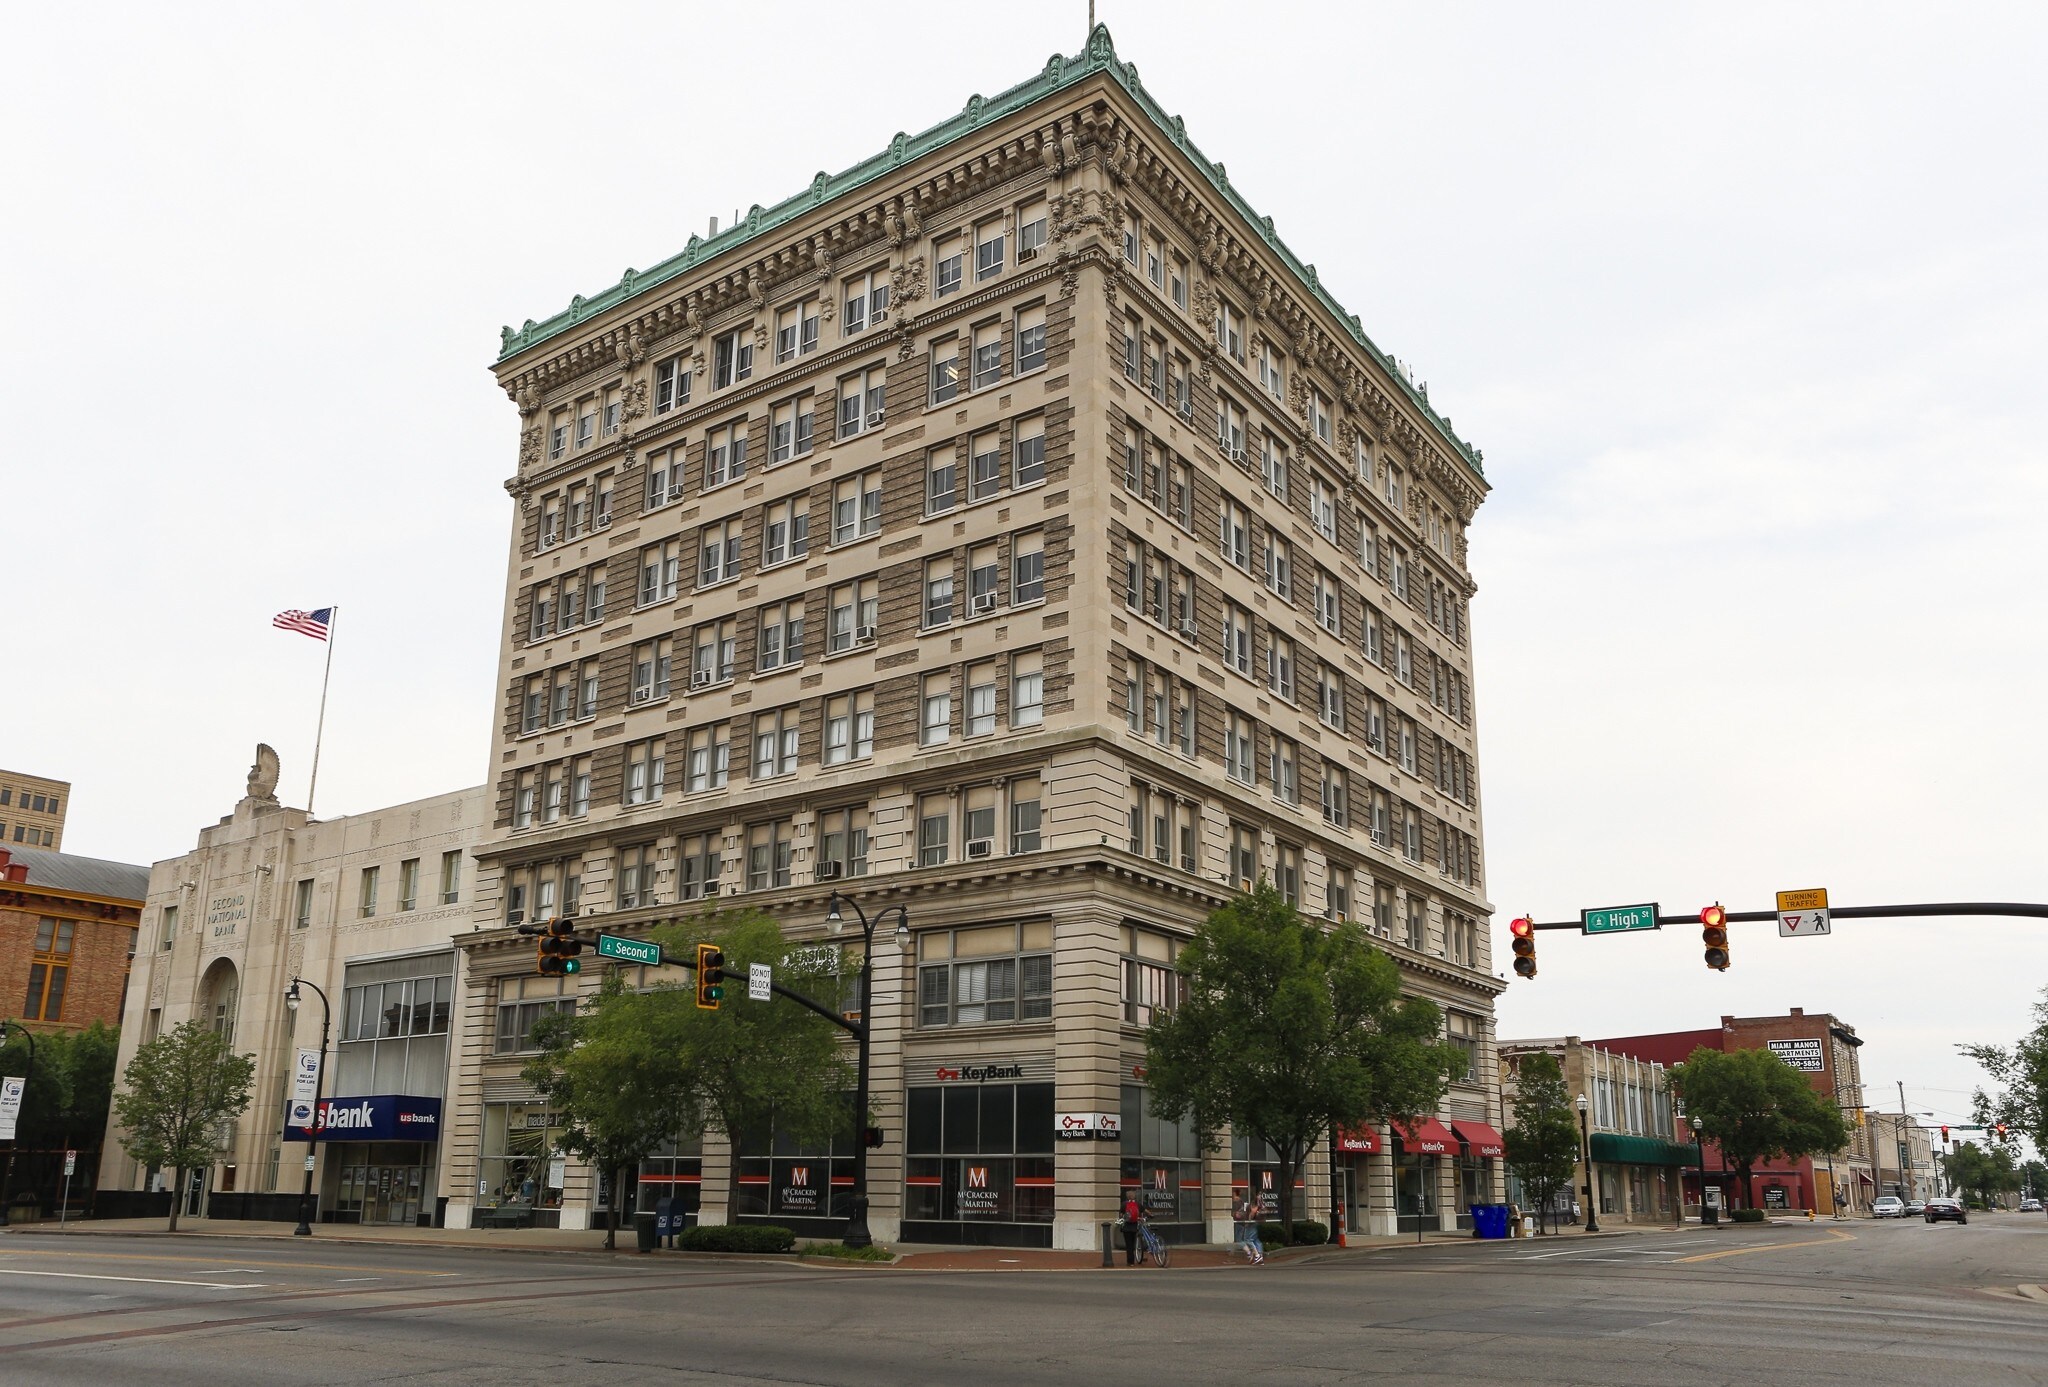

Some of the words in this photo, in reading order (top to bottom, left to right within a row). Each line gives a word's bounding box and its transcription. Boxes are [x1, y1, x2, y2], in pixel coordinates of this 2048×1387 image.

[212, 895, 245, 910] SECOND
[1785, 900, 1817, 908] TRAFFIC
[207, 908, 247, 925] NATIONAL
[1609, 912, 1639, 929] High
[1641, 910, 1649, 918] St
[214, 924, 236, 937] BANK
[615, 942, 648, 959] Second
[751, 968, 759, 977] DO
[760, 969, 770, 978] NOT
[750, 980, 770, 990] BLOCK
[750, 989, 770, 997] INTERSECTION
[1771, 1042, 1792, 1050] MIAMI
[1794, 1041, 1819, 1049] MANOR
[961, 1064, 1023, 1083] KeyBank
[1062, 1130, 1073, 1139] Key
[1344, 1139, 1362, 1150] KeyBank
[1421, 1142, 1438, 1152] KeyBank
[792, 1167, 807, 1186] M
[969, 1167, 986, 1188] M
[1155, 1169, 1167, 1190] M
[1262, 1171, 1272, 1190] M
[965, 1200, 993, 1208] MARTIN
